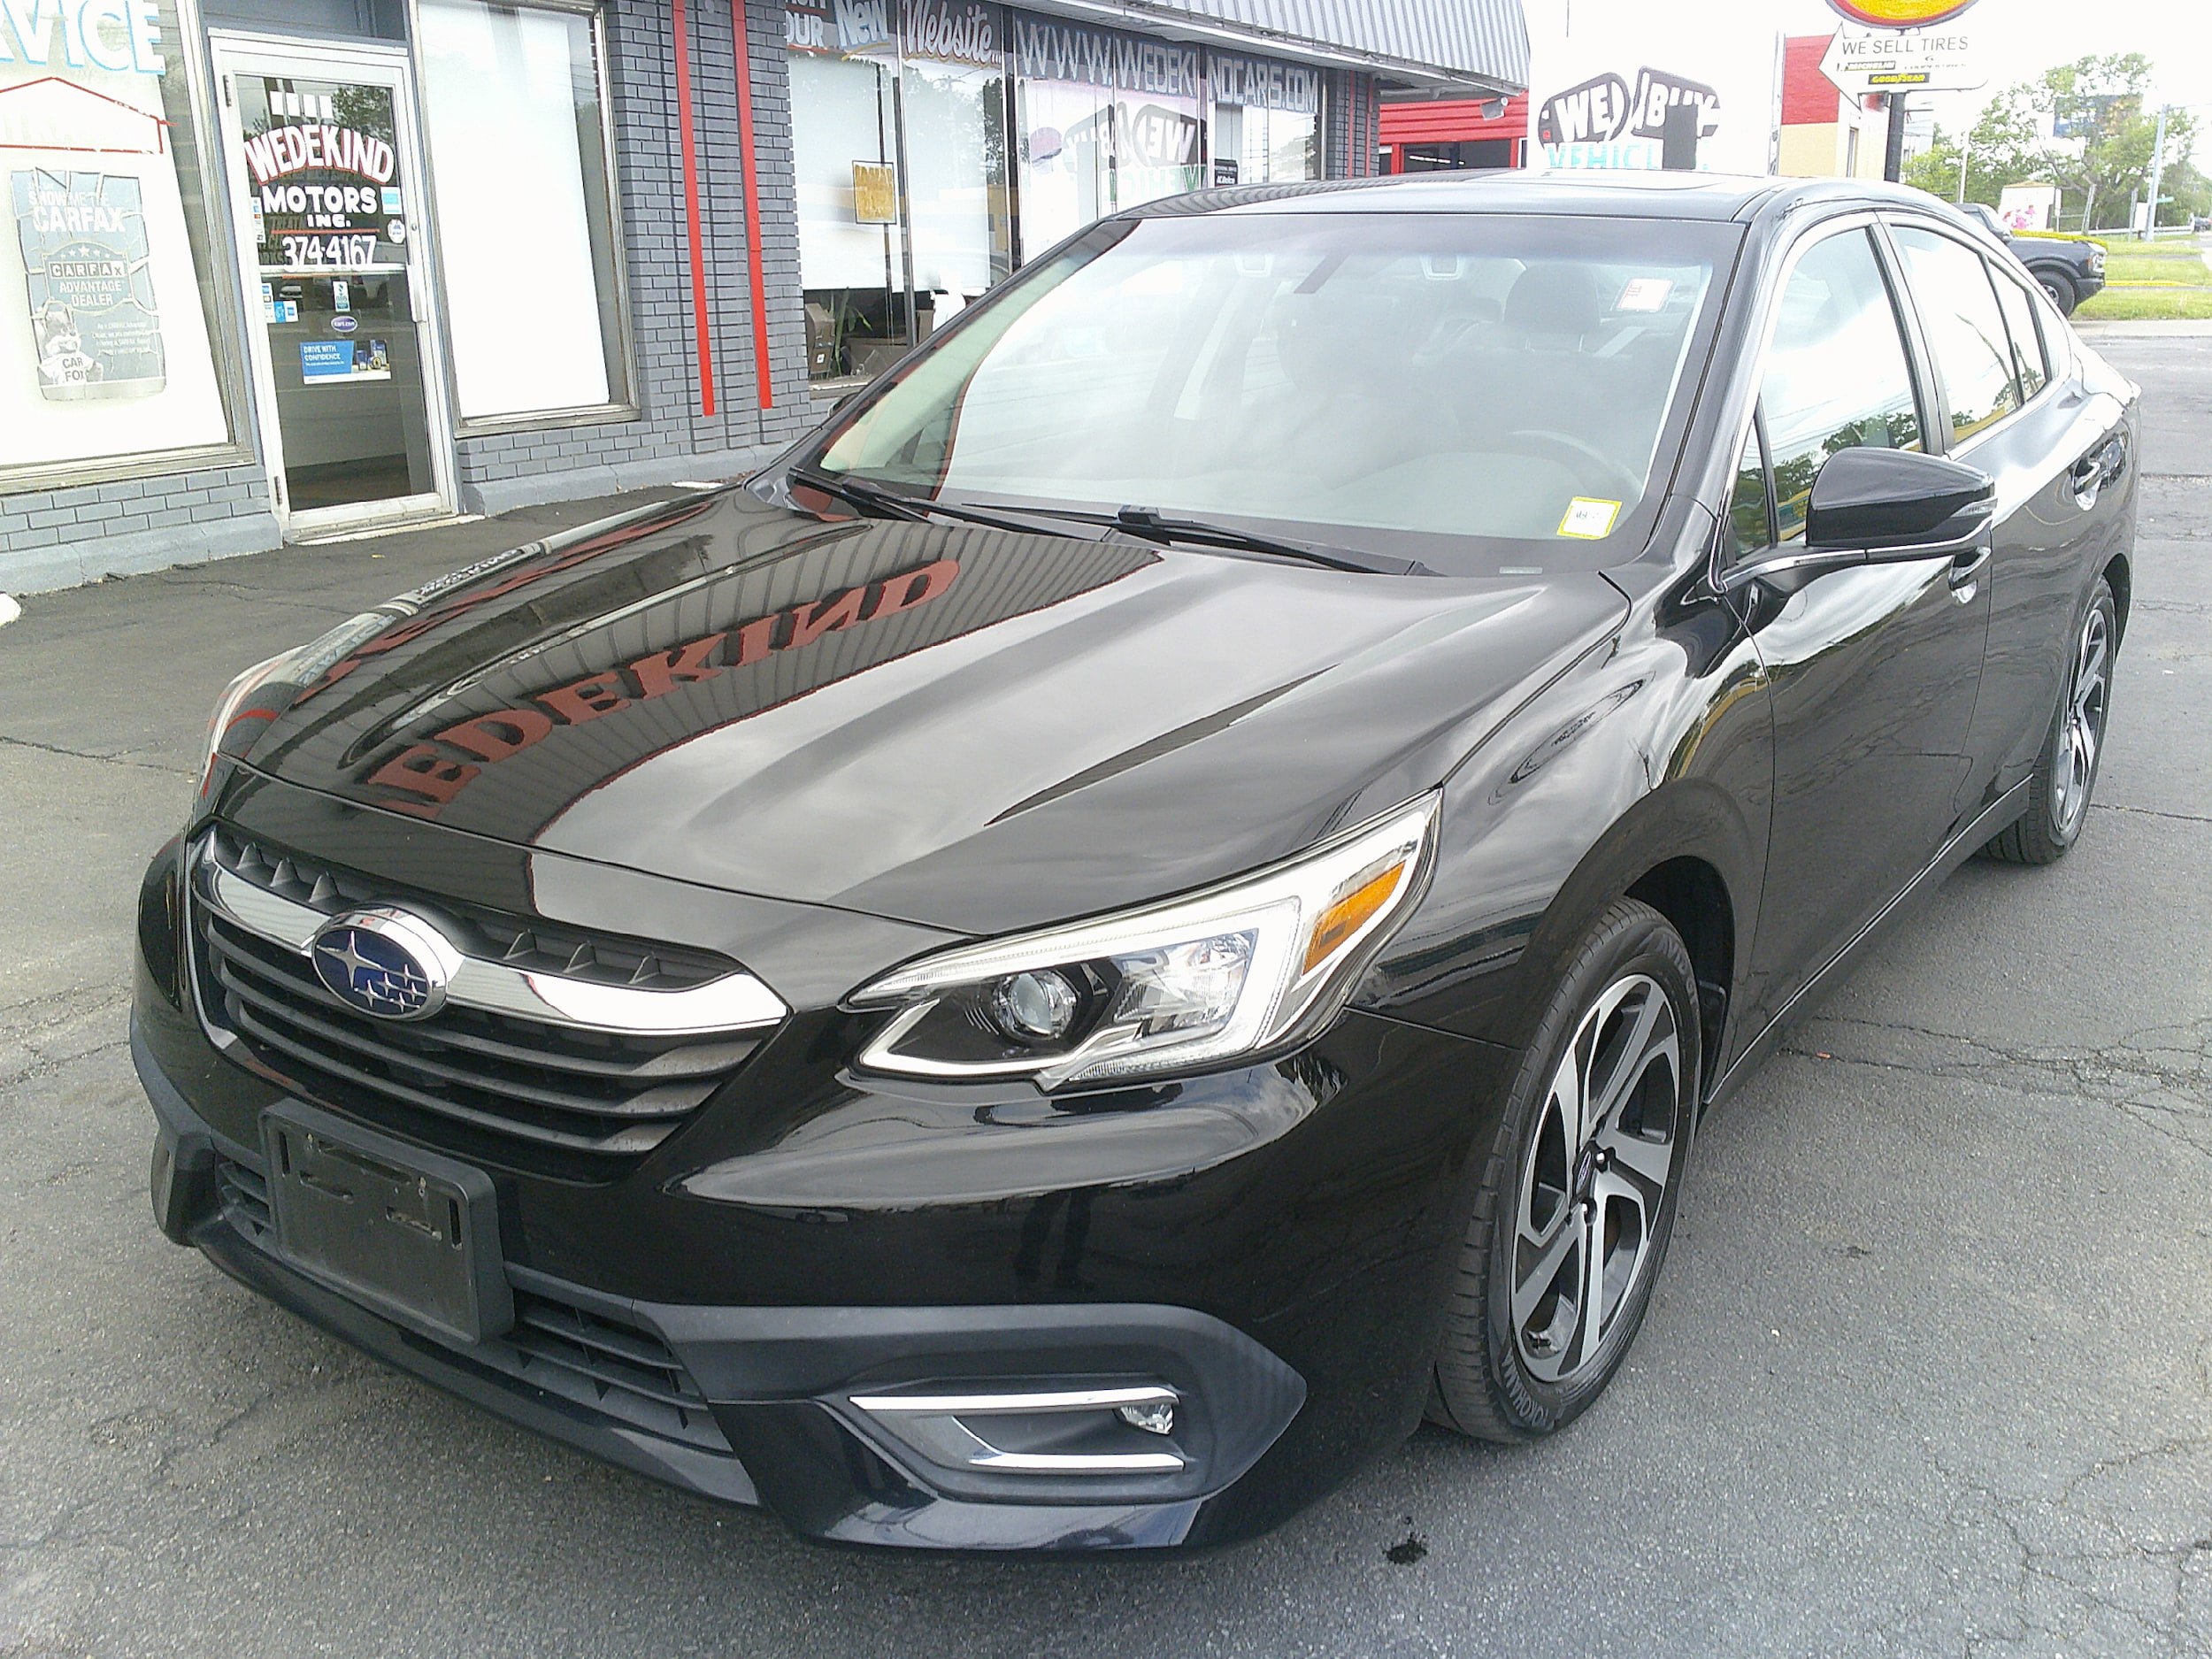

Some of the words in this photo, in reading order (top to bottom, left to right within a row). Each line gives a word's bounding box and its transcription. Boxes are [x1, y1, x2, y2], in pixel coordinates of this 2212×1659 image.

[0, 0, 165, 74] VICE
[1842, 41, 1867, 55] WE
[1872, 40, 1914, 54] SELL
[1921, 36, 1969, 50] TIRES
[1871, 73, 1926, 84] GOODYEAR
[243, 124, 395, 186] WEDEKIND
[262, 186, 378, 214] MOTORS
[33, 206, 127, 233] CARFAX
[307, 214, 352, 228] INC.
[50, 262, 126, 278] CARFAX
[59, 280, 122, 294] ADVANTAGE
[72, 294, 113, 307] DEALER
[62, 357, 84, 369] CAR
